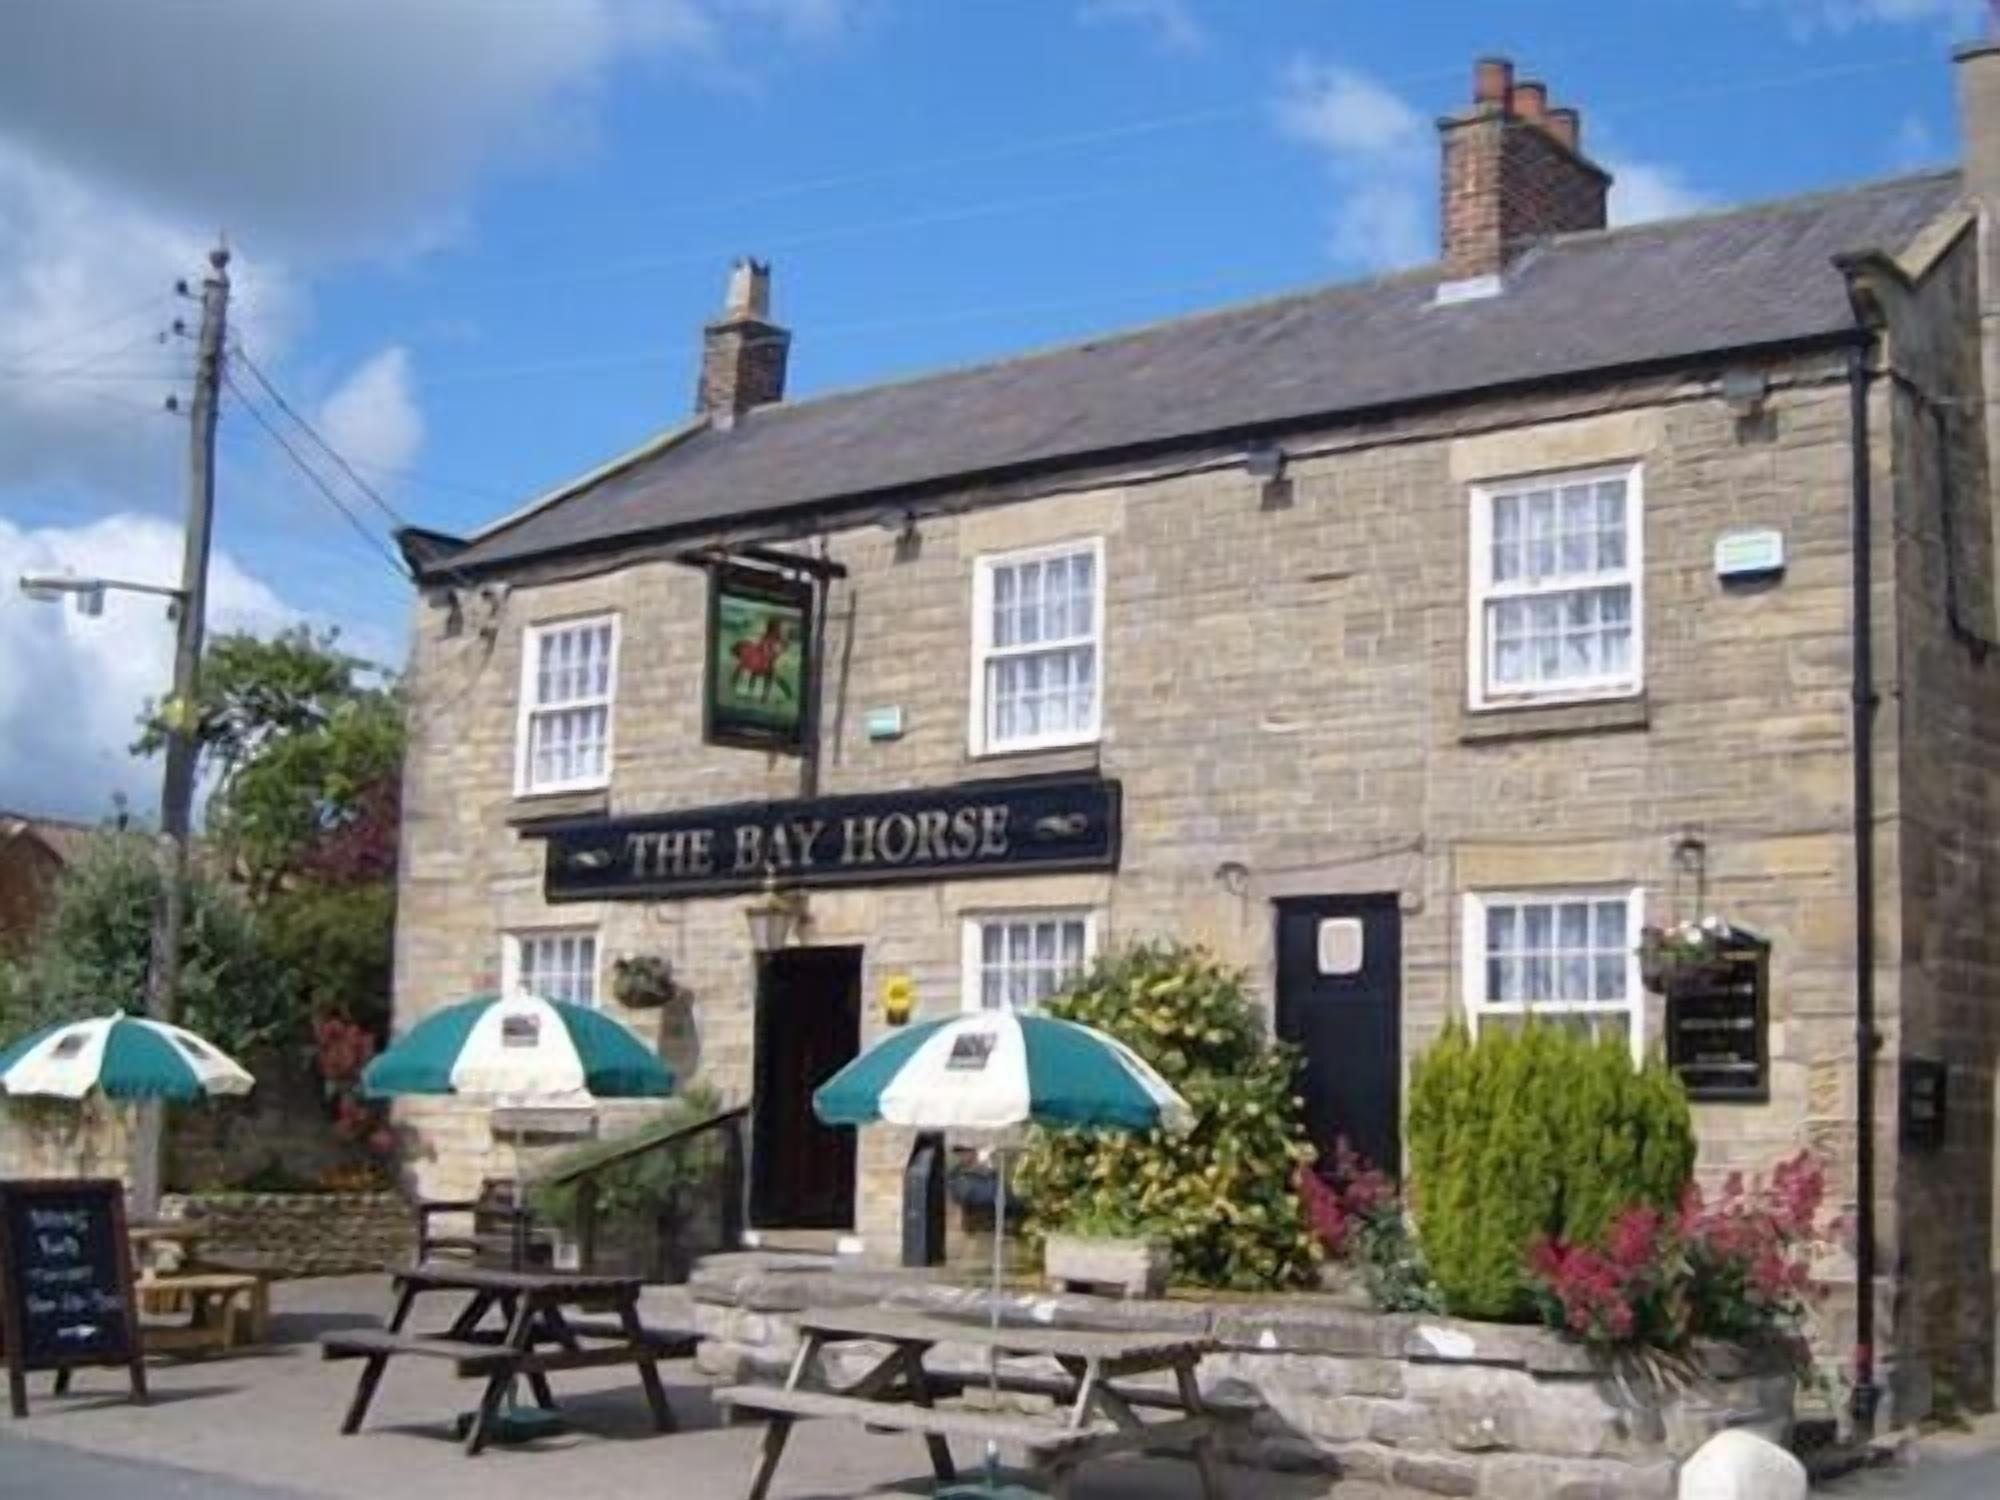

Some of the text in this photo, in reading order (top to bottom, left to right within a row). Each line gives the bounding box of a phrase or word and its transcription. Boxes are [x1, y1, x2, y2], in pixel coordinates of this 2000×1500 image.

[628, 806, 1010, 876] THE BAY HORSE
